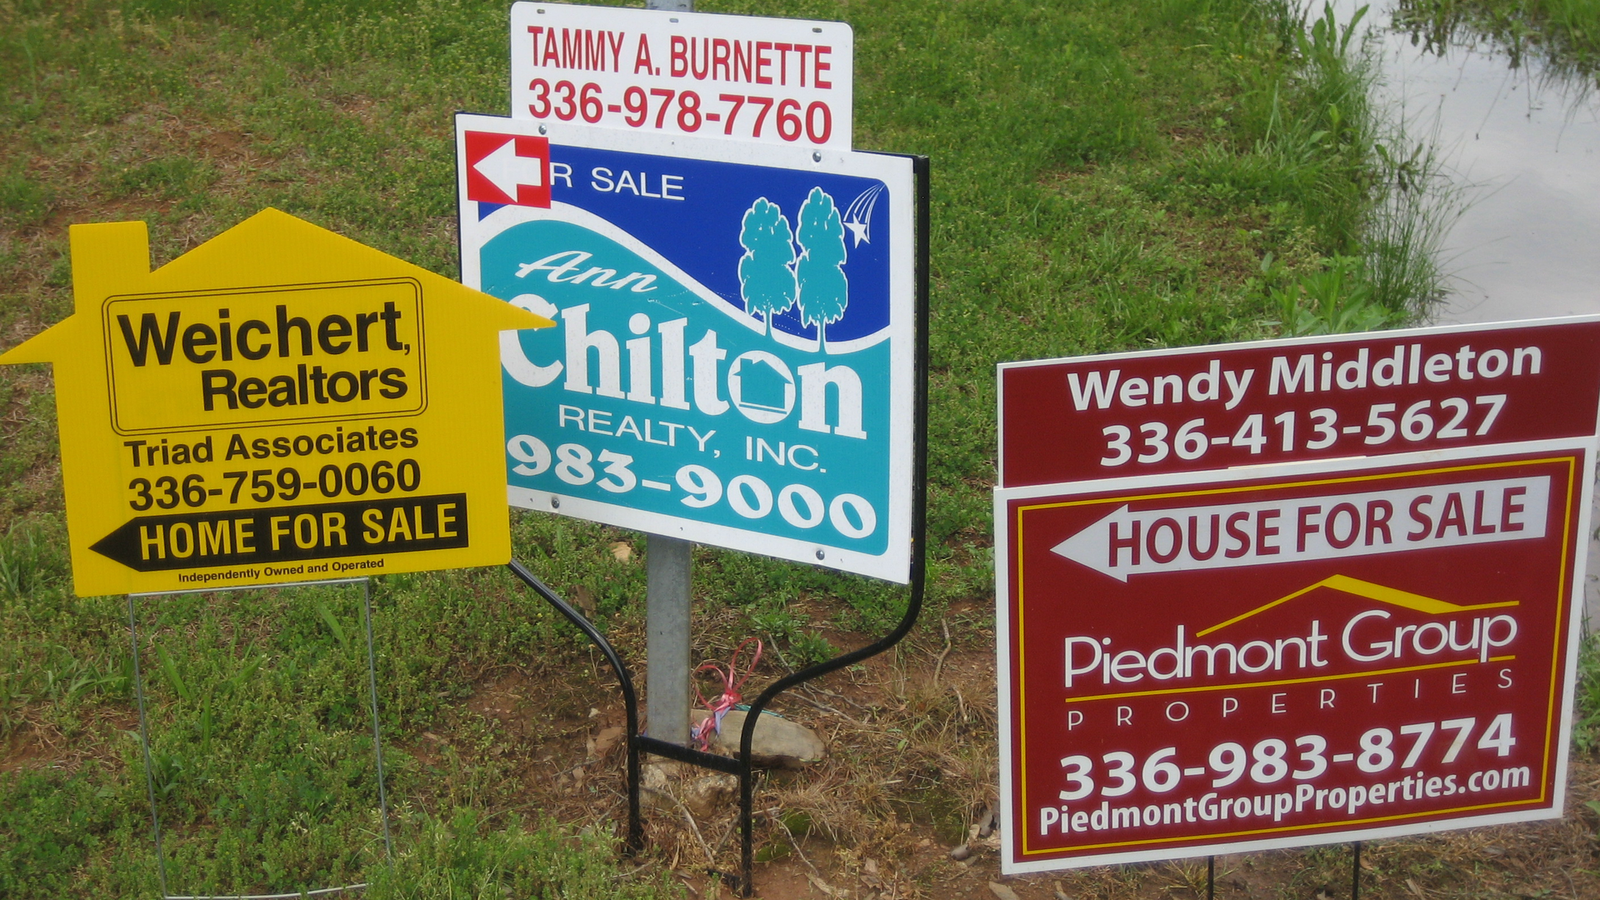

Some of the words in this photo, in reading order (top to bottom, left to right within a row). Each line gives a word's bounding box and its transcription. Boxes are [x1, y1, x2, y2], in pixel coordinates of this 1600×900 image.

[527, 25, 625, 73] TAMMY
[634, 33, 661, 76] A.
[670, 35, 832, 90] BURNETTE
[528, 78, 832, 144] 336-978-7760
[591, 166, 685, 201] SALE
[514, 250, 659, 293] Ann
[117, 301, 412, 368] Weichert,
[499, 293, 867, 440] Chilton
[201, 363, 408, 412] Realtors
[1066, 360, 1255, 411] Wendy
[1268, 343, 1543, 396] Middleton
[124, 436, 214, 468] Triad
[225, 426, 419, 462] Associates
[558, 404, 720, 458] REALTY,
[746, 437, 827, 473] INC.
[1099, 393, 1507, 467] 336-413-5627
[128, 458, 421, 511] 336-759-0060
[507, 434, 877, 539] 983-9000
[139, 518, 256, 561] HOME
[270, 510, 348, 552] FOR
[362, 502, 458, 545] SALE
[1108, 508, 1282, 567] HOUSE
[1296, 499, 1393, 552] FOR
[1407, 485, 1527, 541] SALE
[178, 568, 261, 583] Independently
[263, 565, 304, 577] Owned
[306, 562, 329, 575] and
[331, 558, 385, 573] Operated
[1064, 619, 1329, 689] Piedmont
[1341, 609, 1518, 664] Group
[1067, 667, 1513, 731] PROPERTIES
[1058, 713, 1516, 800] 336-983-8774
[1039, 763, 1531, 836] PiedmontGroupProperties.com
